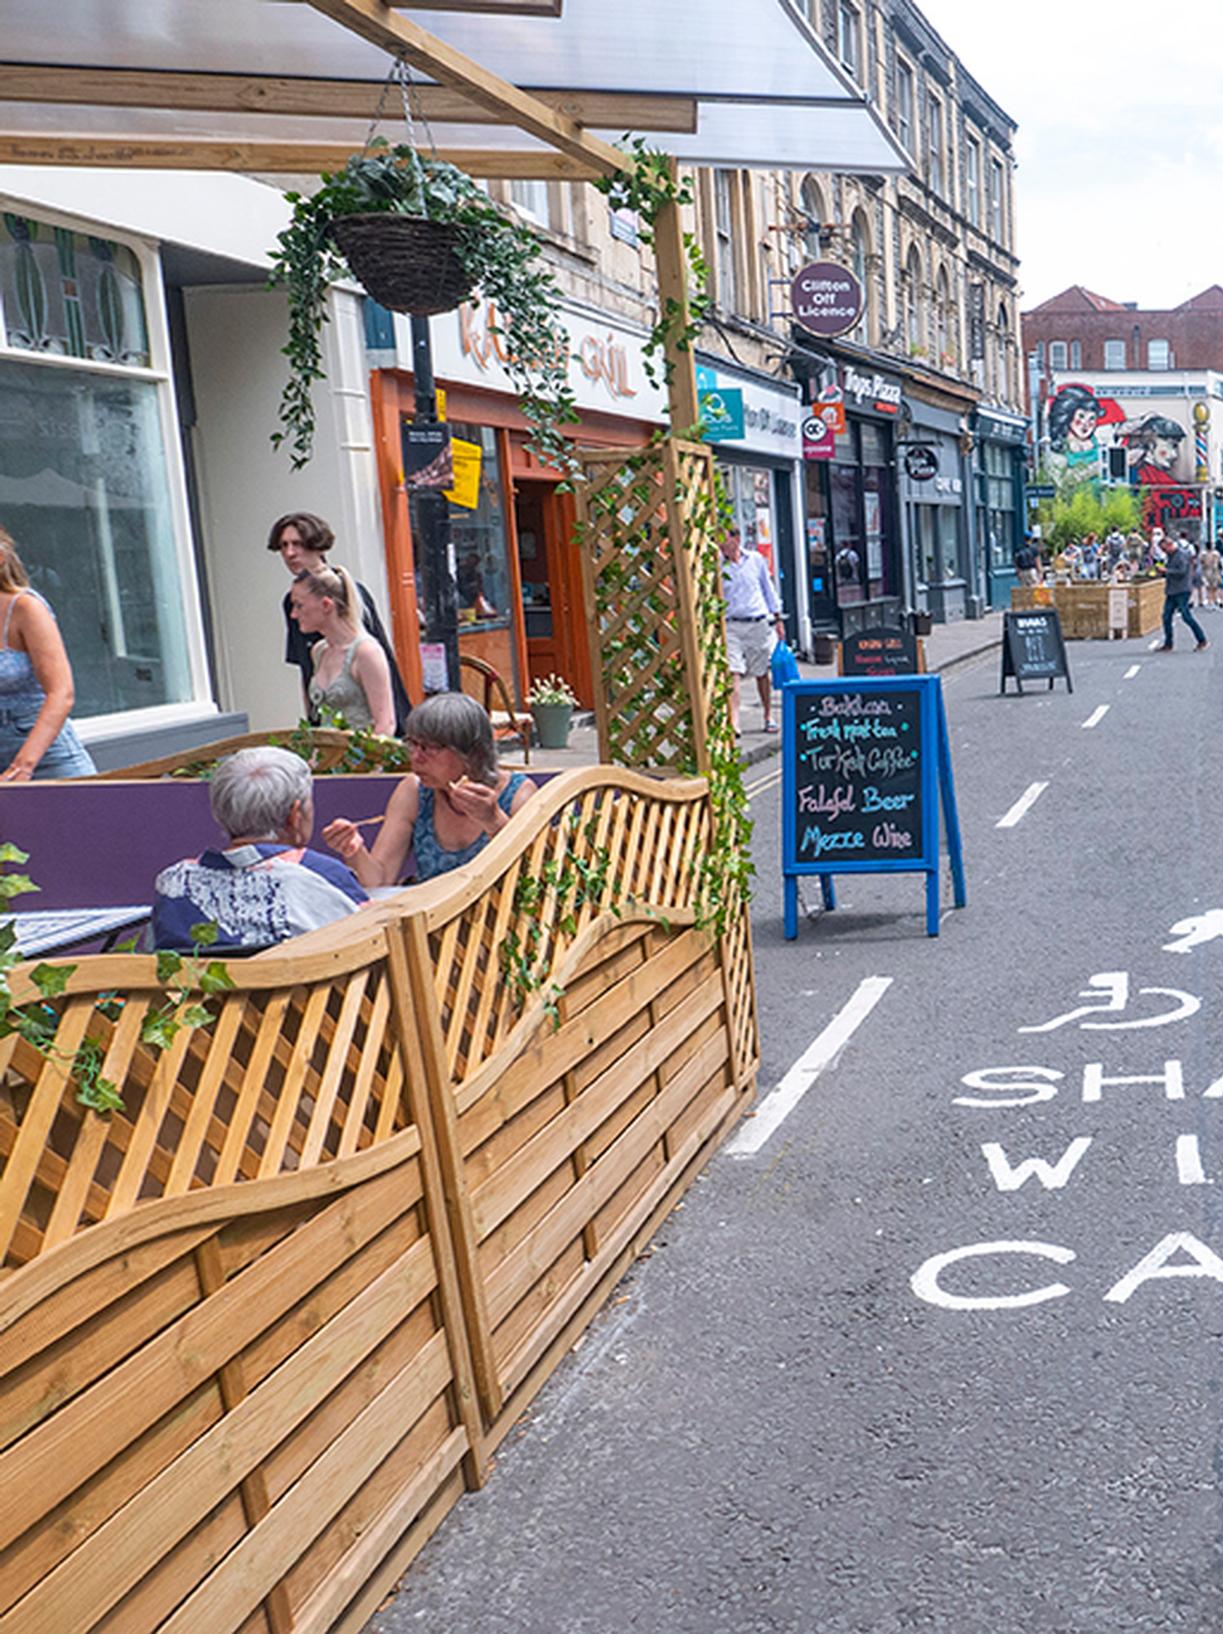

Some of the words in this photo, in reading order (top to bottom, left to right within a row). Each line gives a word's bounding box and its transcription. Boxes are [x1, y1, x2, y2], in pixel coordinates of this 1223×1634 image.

[801, 280, 850, 292] Clifton
[812, 293, 836, 305] Off
[798, 305, 856, 317] Licence
[844, 366, 872, 404] Tops
[872, 374, 900, 404] Pizza
[806, 718, 841, 741] Fresh
[871, 718, 898, 738] tea
[798, 784, 856, 822] Falafel
[861, 786, 915, 812] Beer
[801, 825, 865, 857] Mezze
[872, 822, 912, 848] Wine
